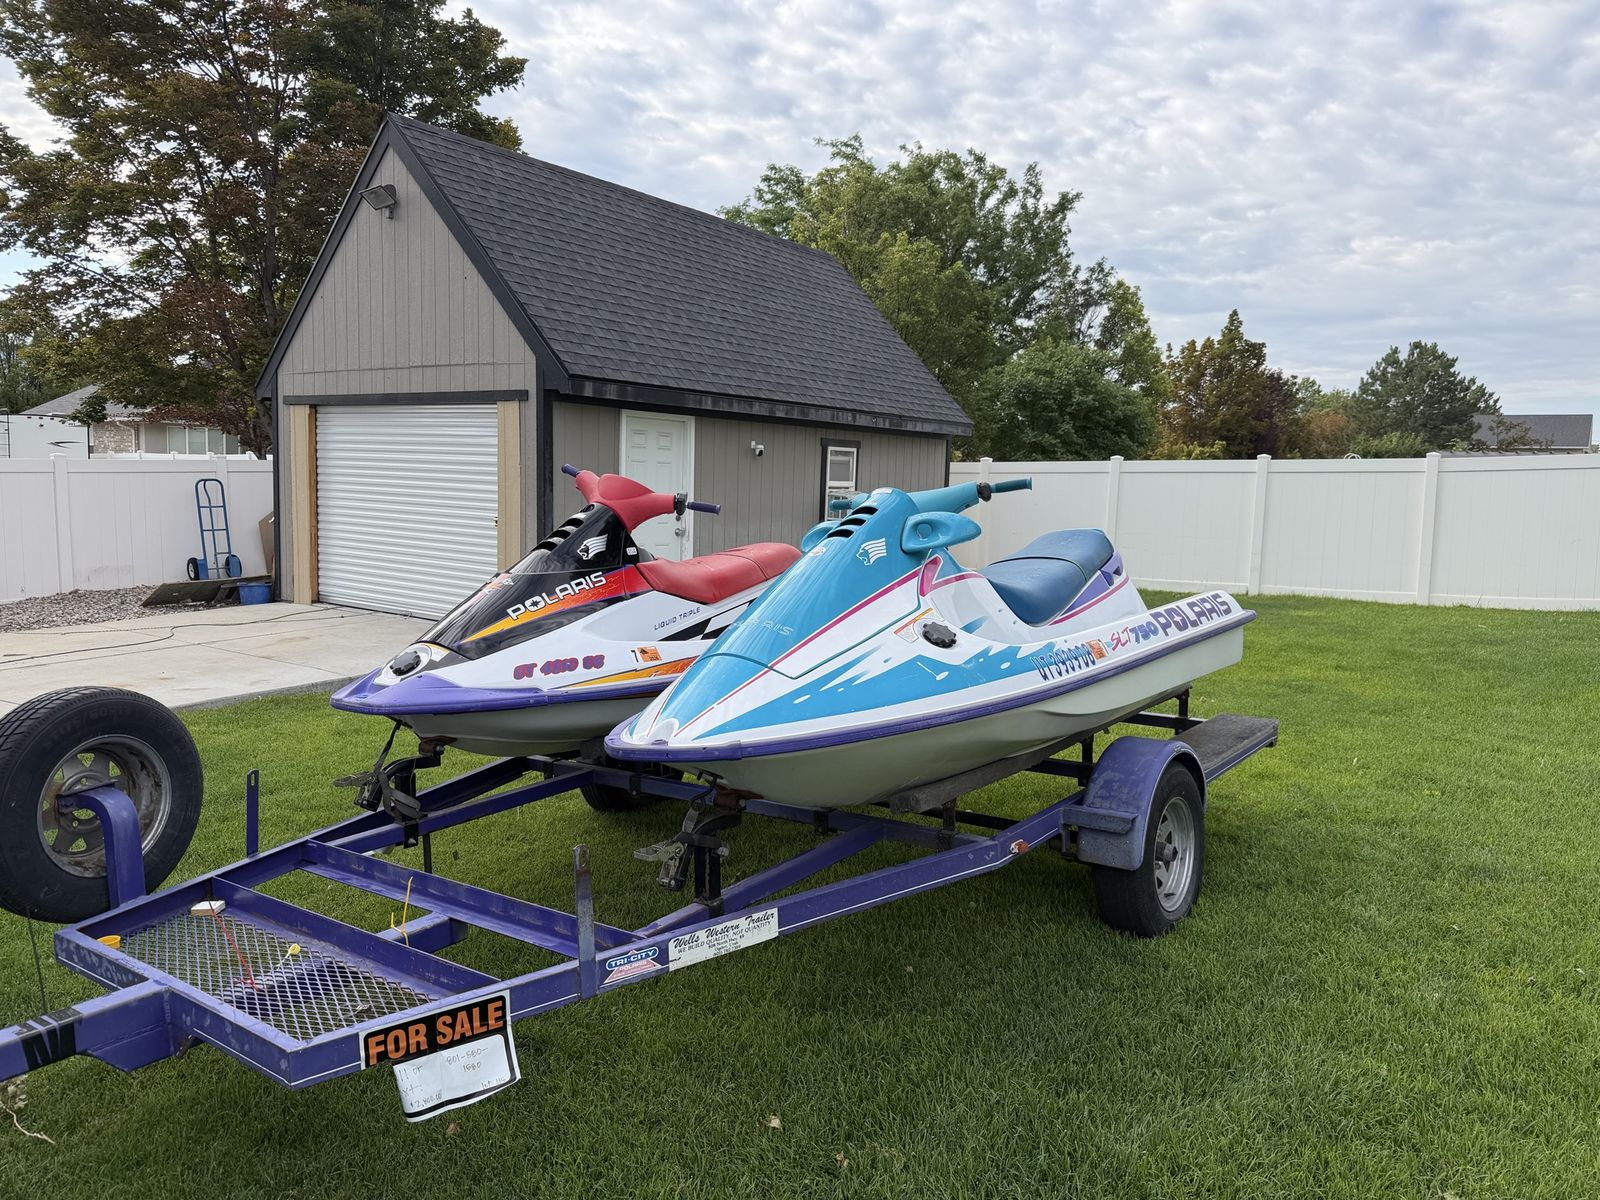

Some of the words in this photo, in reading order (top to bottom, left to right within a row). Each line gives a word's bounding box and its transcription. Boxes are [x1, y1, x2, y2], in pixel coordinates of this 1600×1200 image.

[506, 571, 607, 620] POLARIS
[654, 616, 677, 631] LIQUID
[679, 606, 701, 621] TRIPLE
[1109, 626, 1131, 651] SLT
[1130, 621, 1159, 645] 750
[1153, 593, 1232, 636] POLARIS
[672, 934, 700, 949] Wells
[705, 923, 740, 939] Western
[745, 911, 775, 927] Trailer
[677, 946, 686, 954] WE
[687, 941, 705, 951] BUILD
[732, 929, 744, 938] NOT
[744, 920, 772, 933] QUANTITY
[367, 1023, 428, 1066] FOR
[436, 1000, 504, 1045] SALE
